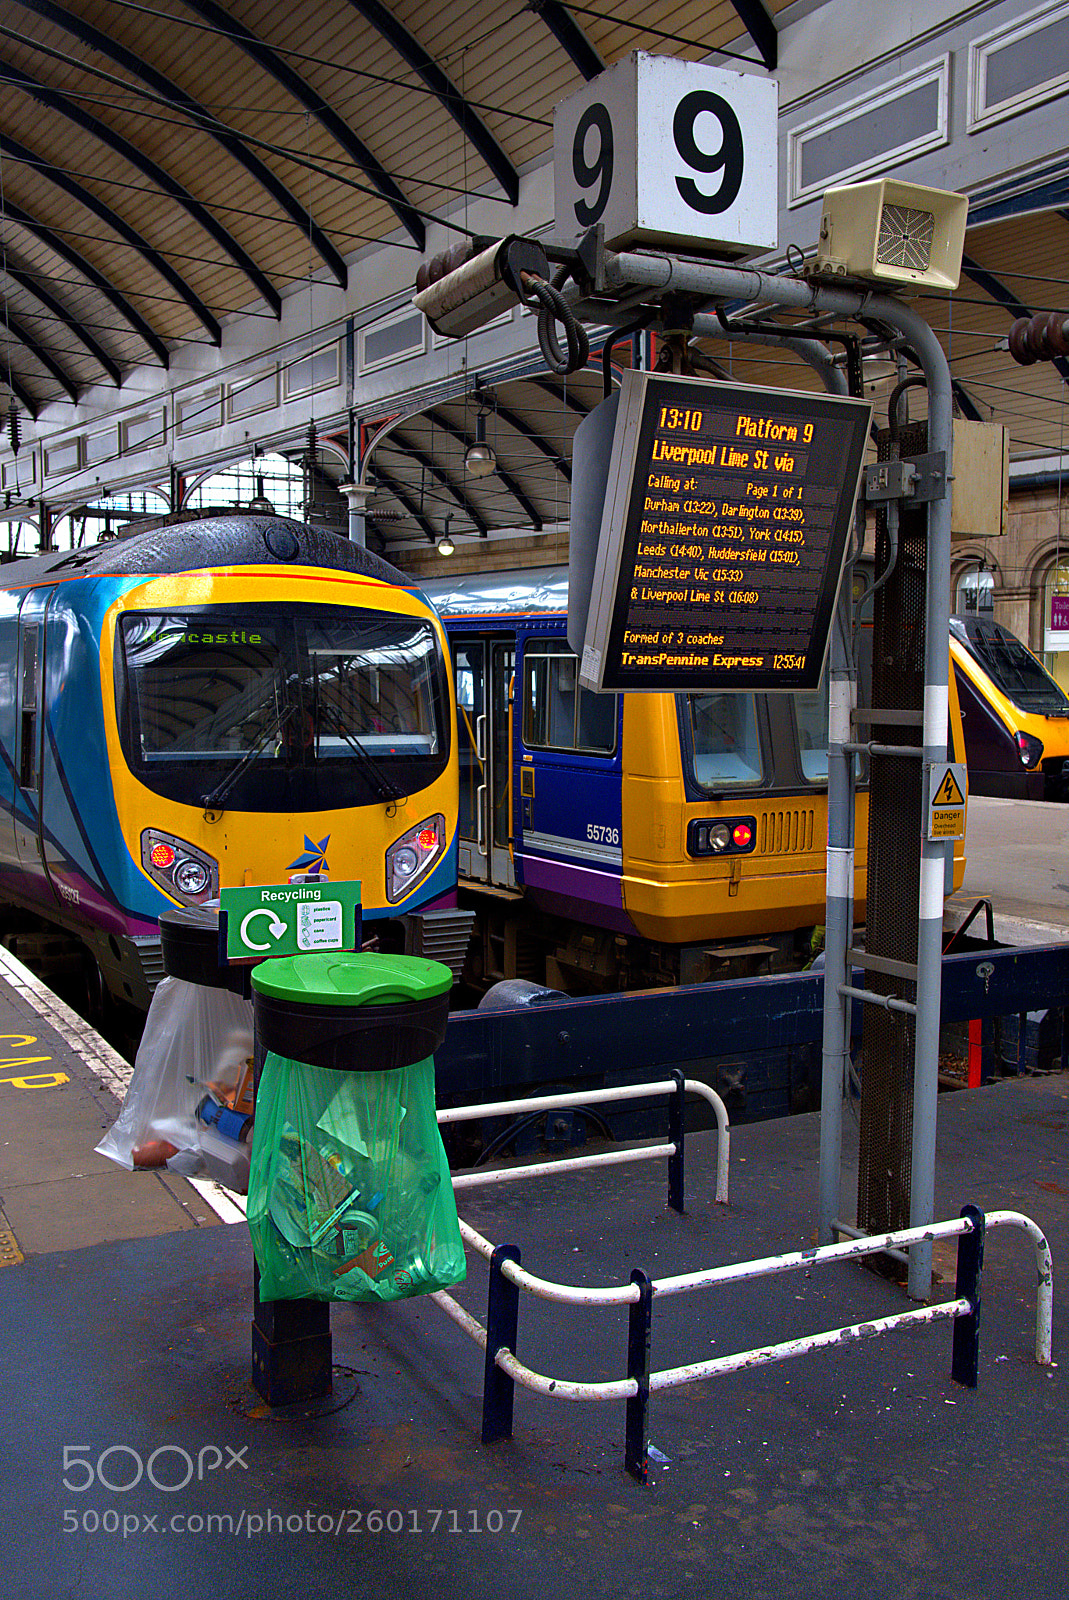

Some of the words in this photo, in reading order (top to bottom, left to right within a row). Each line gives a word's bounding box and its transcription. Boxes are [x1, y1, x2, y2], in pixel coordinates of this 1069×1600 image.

[673, 90, 744, 214] 9
[572, 103, 614, 227] 9
[660, 408, 703, 431] 13:10
[736, 416, 798, 442] Platform
[802, 423, 814, 444] 9
[652, 440, 717, 466] Liverpool
[720, 446, 749, 468] Lime
[753, 449, 769, 470] St
[774, 452, 795, 473] via
[647, 474, 681, 493] Calling
[683, 477, 699, 491] at:
[746, 482, 769, 499] Page
[772, 484, 778, 498] 1
[782, 486, 795, 500] of
[797, 486, 804, 500] 1
[643, 497, 680, 512] Durham
[721, 502, 770, 521] Darlington
[640, 520, 709, 537] Northallerton
[749, 526, 771, 541] York
[636, 542, 667, 557] Leeds
[708, 546, 767, 563] Huddersfield
[633, 564, 691, 580] Manchester
[694, 566, 710, 581] Vic
[711, 568, 744, 582] (15:33)
[630, 586, 639, 601] &
[641, 587, 688, 604] Liverpool
[690, 589, 711, 603] Lime
[713, 590, 725, 603] St
[623, 630, 659, 645] Formed
[661, 631, 674, 645] of
[676, 632, 684, 645] 3
[686, 632, 725, 646] coaches
[621, 651, 709, 667] TransPennine
[712, 653, 764, 669] Express
[772, 654, 806, 670] 12:55:41
[934, 811, 961, 820] Danger
[586, 823, 620, 844] 55736
[261, 888, 321, 902] Recycling
